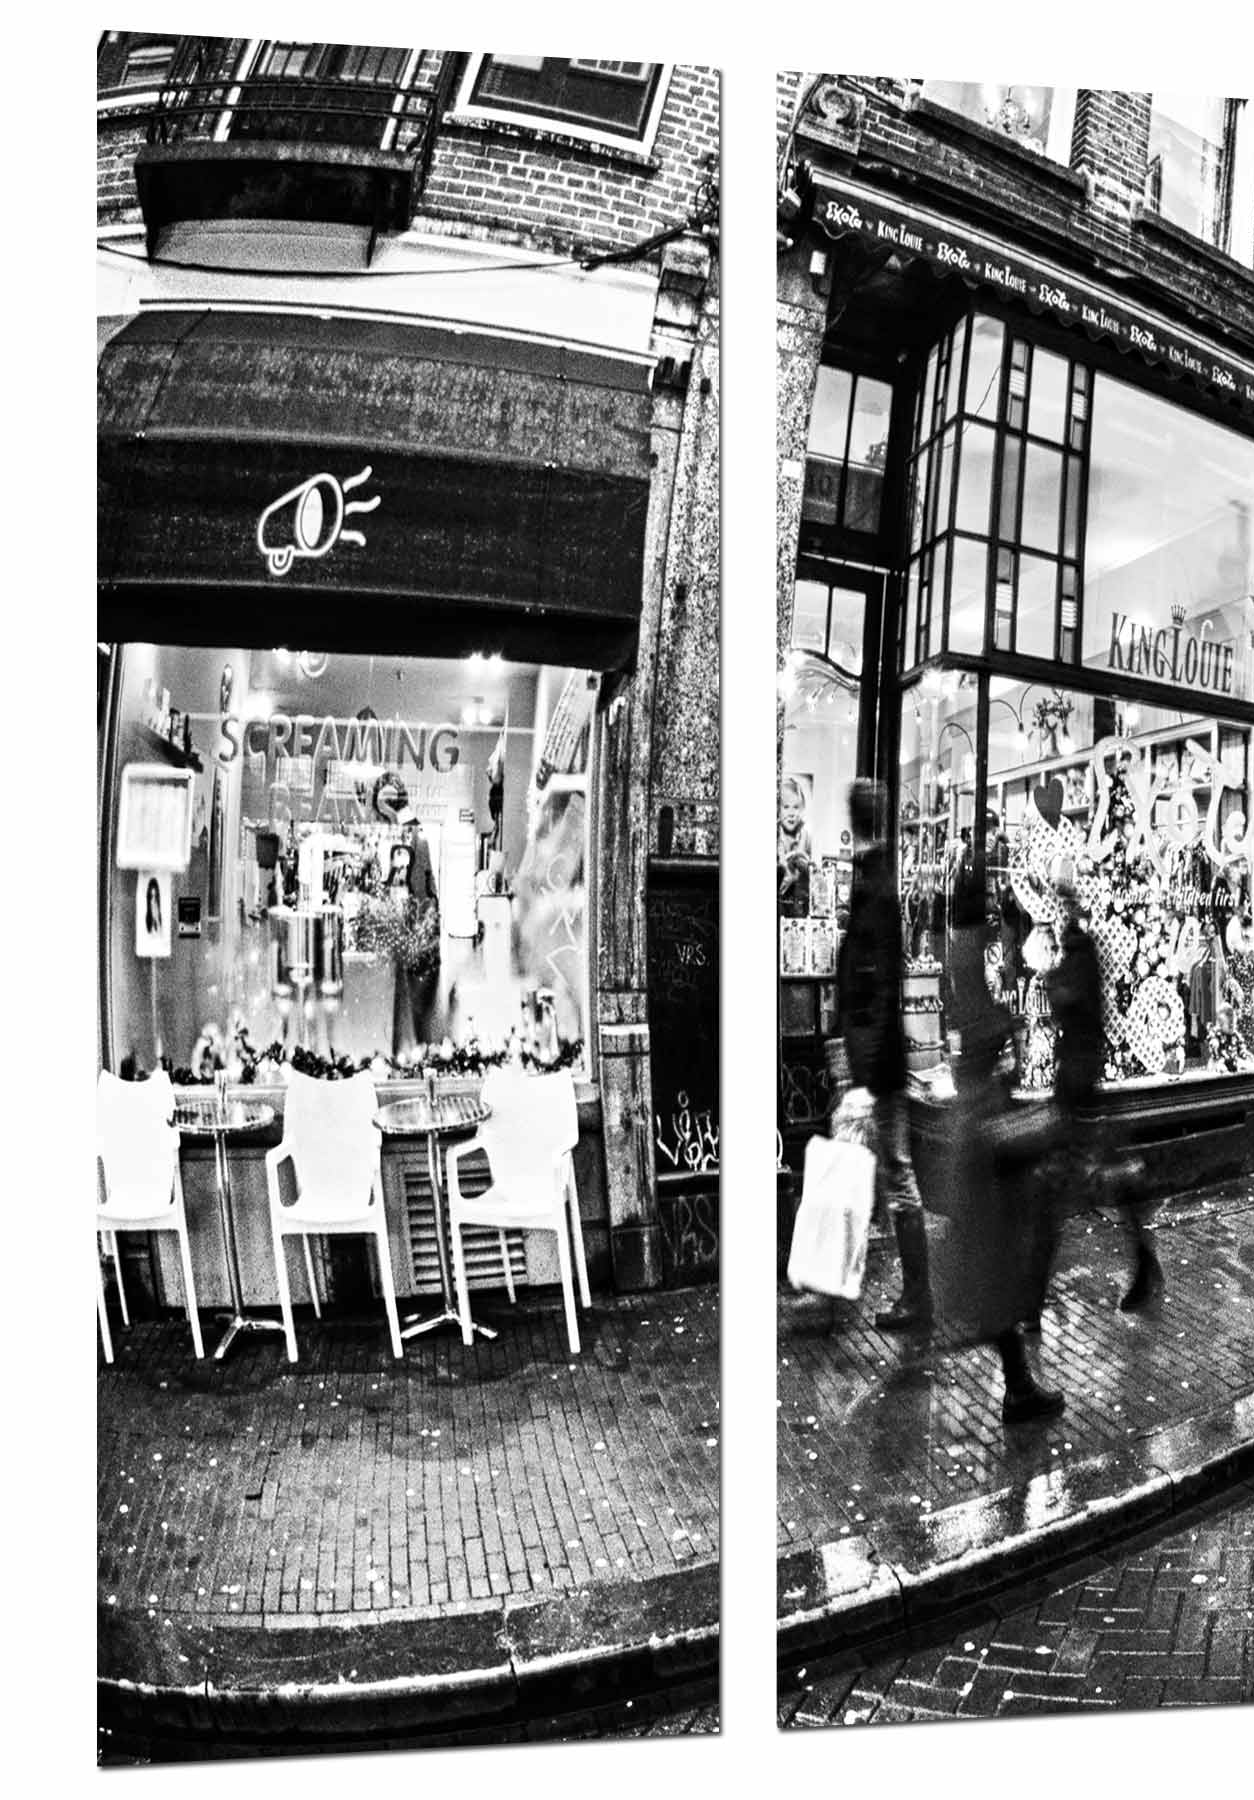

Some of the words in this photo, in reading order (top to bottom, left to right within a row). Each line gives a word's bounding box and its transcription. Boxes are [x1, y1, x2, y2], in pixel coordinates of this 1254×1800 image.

[826, 201, 862, 230] Exota
[877, 220, 899, 244] KING
[899, 224, 924, 251] LOUIE
[936, 241, 972, 270] Exota
[984, 262, 1004, 285] KING
[1004, 265, 1027, 294] LOUIE
[1108, 612, 1167, 678] KING
[1170, 626, 1234, 693] LOUIE
[218, 714, 460, 774] SCREAMING
